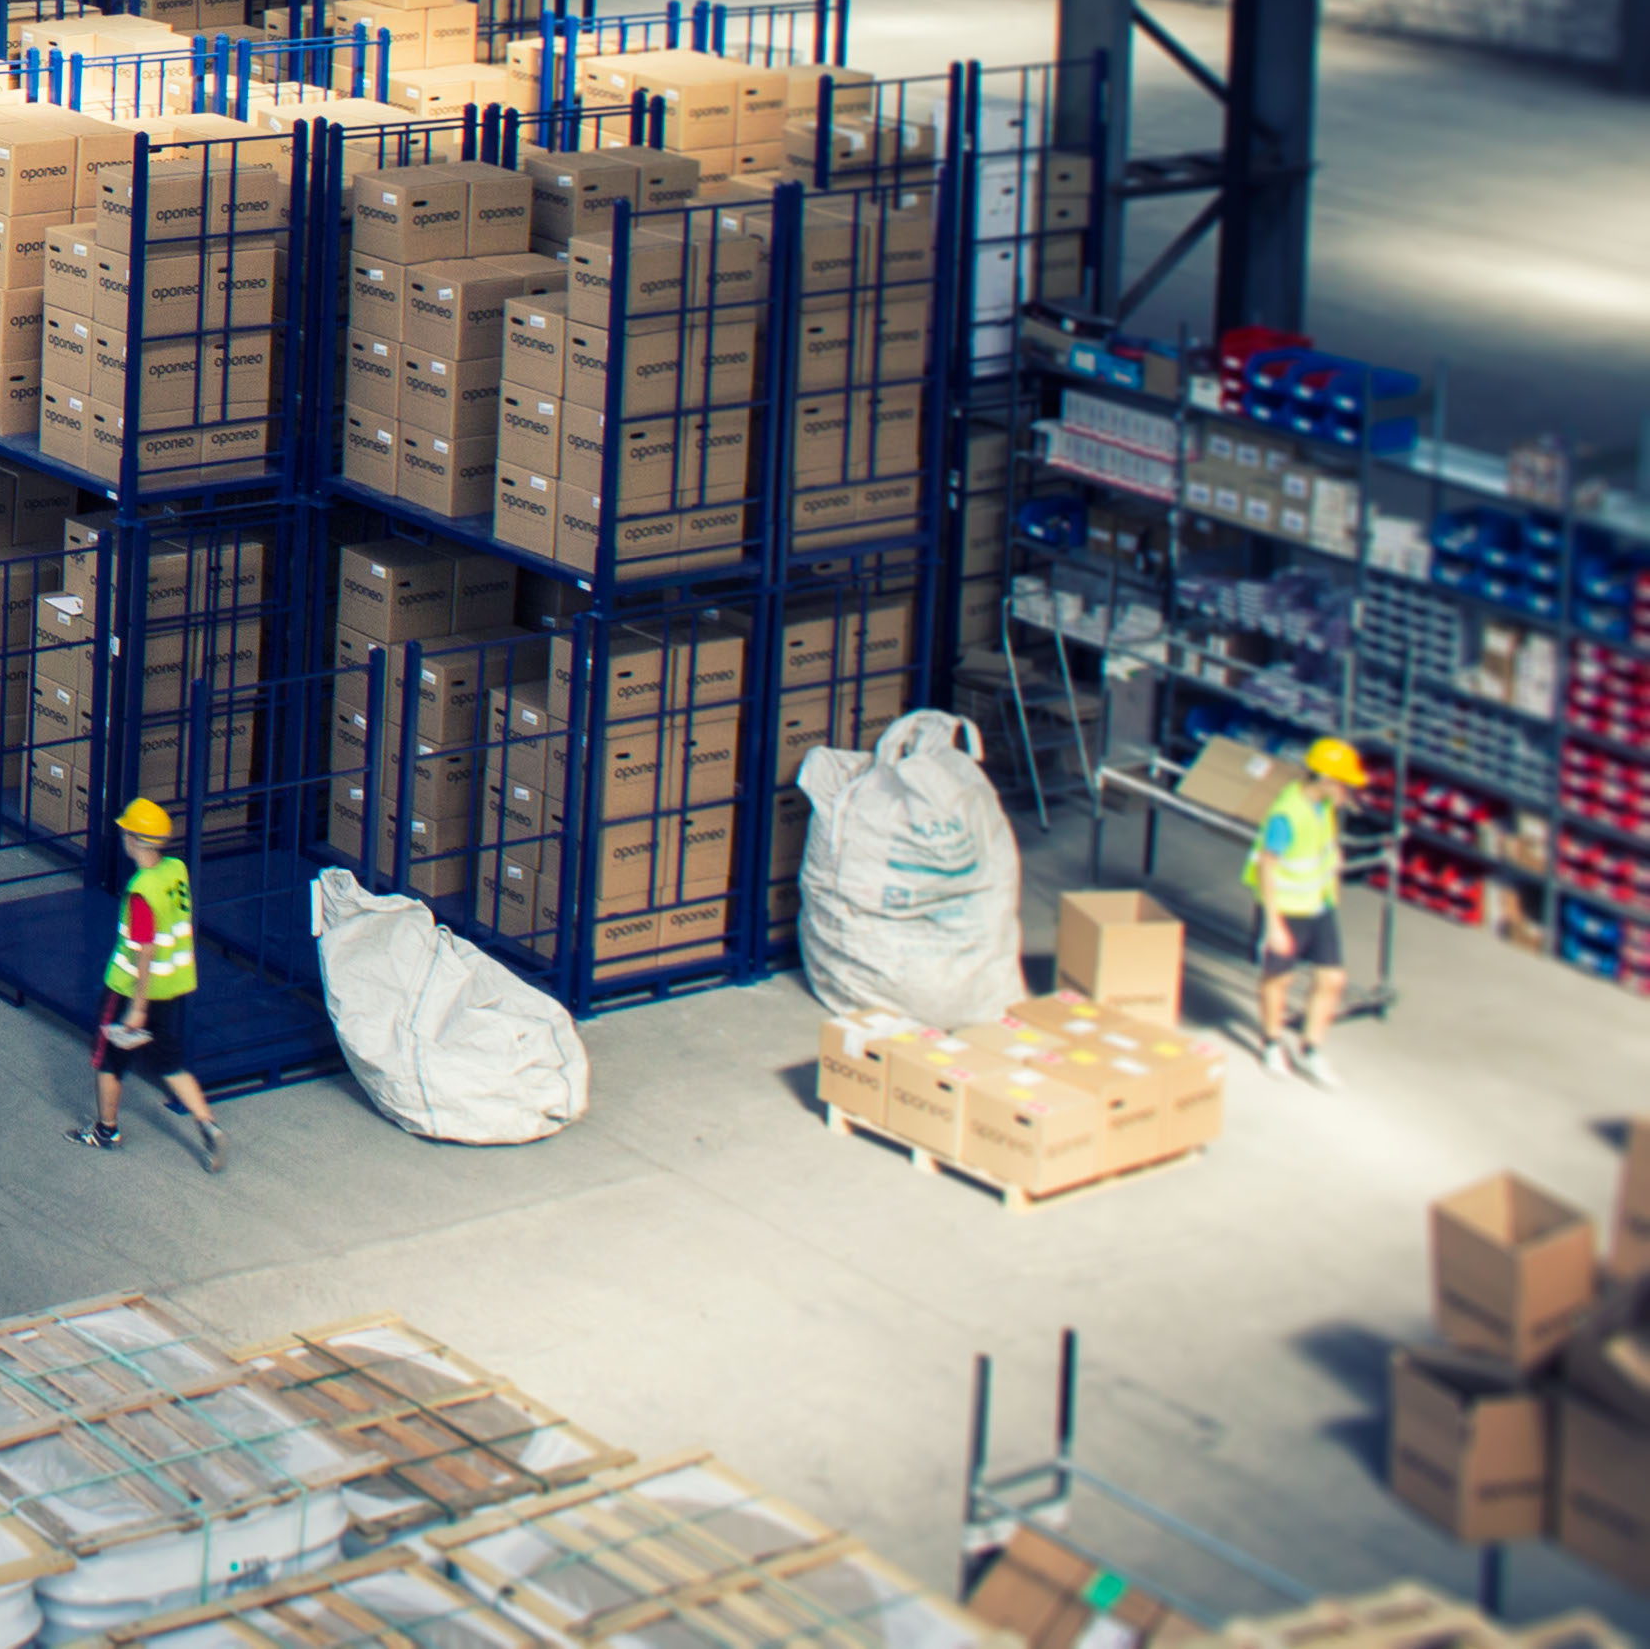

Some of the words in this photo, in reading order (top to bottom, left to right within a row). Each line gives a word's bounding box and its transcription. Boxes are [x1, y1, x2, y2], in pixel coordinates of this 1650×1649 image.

[20, 164, 67, 180] oponeo
[648, 188, 693, 203] oponeo
[357, 202, 398, 225] oponeo
[413, 210, 460, 226] oponeo
[479, 205, 525, 220] oponeo
[49, 258, 87, 279] oponeo
[355, 280, 395, 302] oponeo
[411, 298, 452, 319] oponeo
[48, 332, 83, 355] oponeo
[510, 330, 554, 355] oponeo
[352, 355, 391, 378] oponeo
[406, 374, 446, 398] oponeo
[45, 408, 81, 431] oponeo
[505, 411, 549, 436] oponeo
[146, 436, 194, 454] oponeo
[211, 428, 259, 445] oponeo
[349, 432, 389, 455] oponeo
[405, 452, 444, 476] oponeo
[501, 491, 546, 517] oponeo
[803, 492, 850, 513] oponeo
[865, 485, 911, 505] oponeo
[625, 521, 674, 542] oponeo
[690, 513, 738, 531] oponeo
[344, 577, 383, 602] oponeo
[670, 907, 719, 929] oponeo
[605, 919, 653, 941] oponeo
